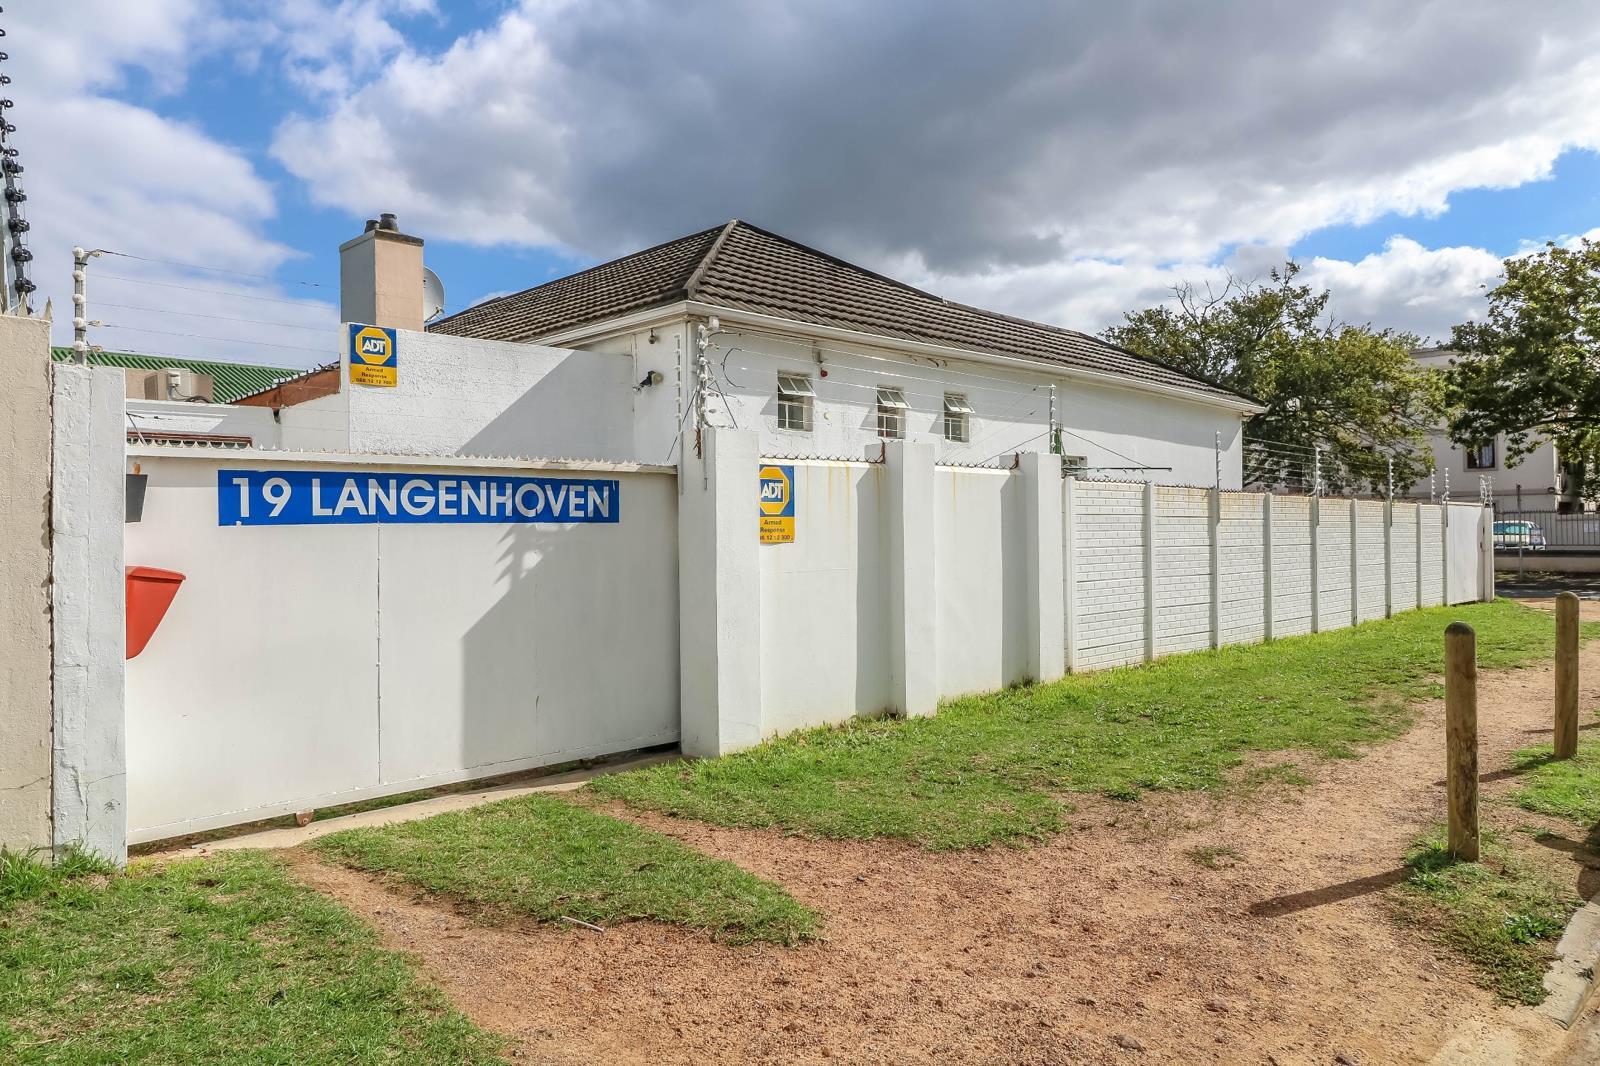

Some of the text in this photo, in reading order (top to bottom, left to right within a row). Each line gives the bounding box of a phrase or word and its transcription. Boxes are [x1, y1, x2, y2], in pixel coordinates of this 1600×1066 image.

[362, 340, 386, 352] ADT
[232, 477, 609, 518] 19 LANGENHOVEN
[761, 483, 783, 498] ADT
